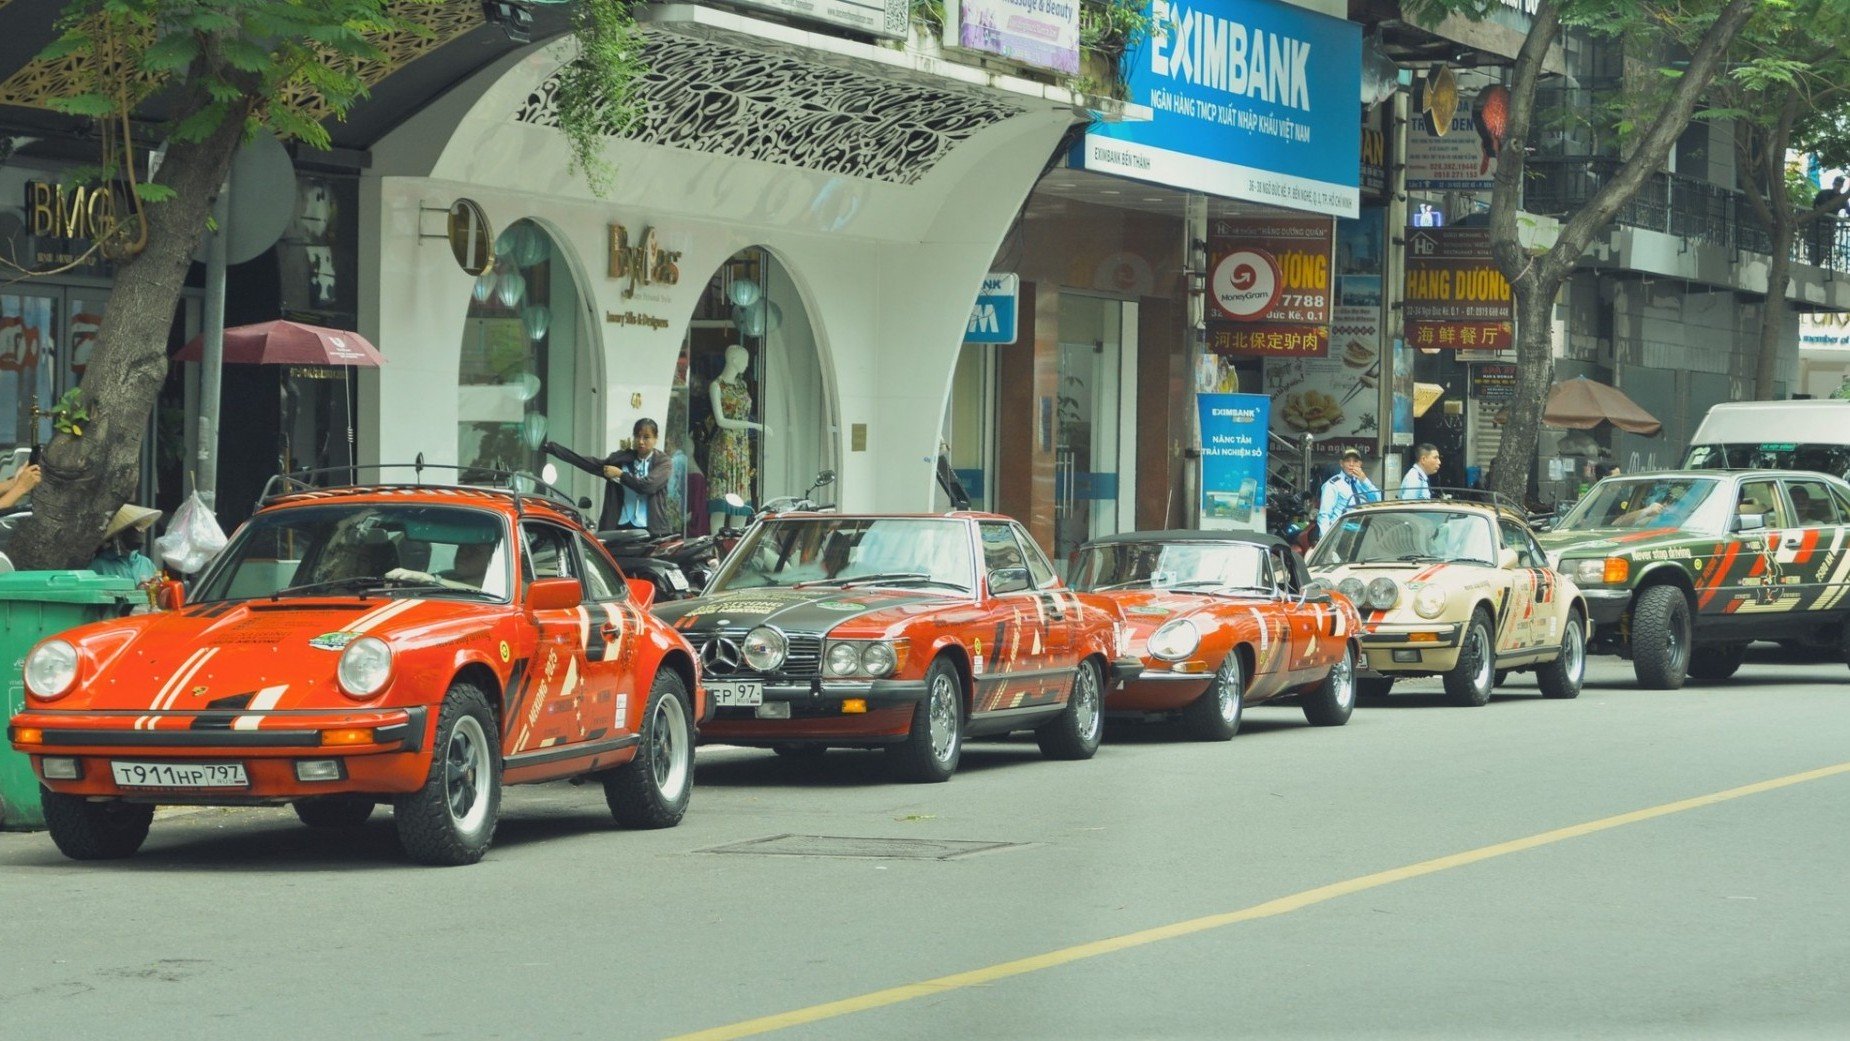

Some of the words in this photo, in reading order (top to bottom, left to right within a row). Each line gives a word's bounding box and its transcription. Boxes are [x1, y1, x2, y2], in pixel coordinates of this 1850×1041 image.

[1046, 1, 1073, 24] Beauty
[1151, 0, 1311, 112] EXIMBANK
[1173, 90, 1195, 117] HÀNG
[1196, 99, 1217, 122] TMCP
[1406, 262, 1450, 300] HÀNG
[1455, 265, 1510, 300] DƯƠNG
[1220, 291, 1269, 303] MoneyGram
[1282, 294, 1325, 308] 7788
[1214, 330, 1318, 351] 河北保定驴肉
[1417, 325, 1498, 345] 海鲜餐厅
[1803, 334, 1838, 344] member
[1212, 408, 1255, 417] EXIMBANK
[738, 684, 755, 699] 97
[528, 678, 548, 728] MEKONG
[206, 765, 239, 780] 797
